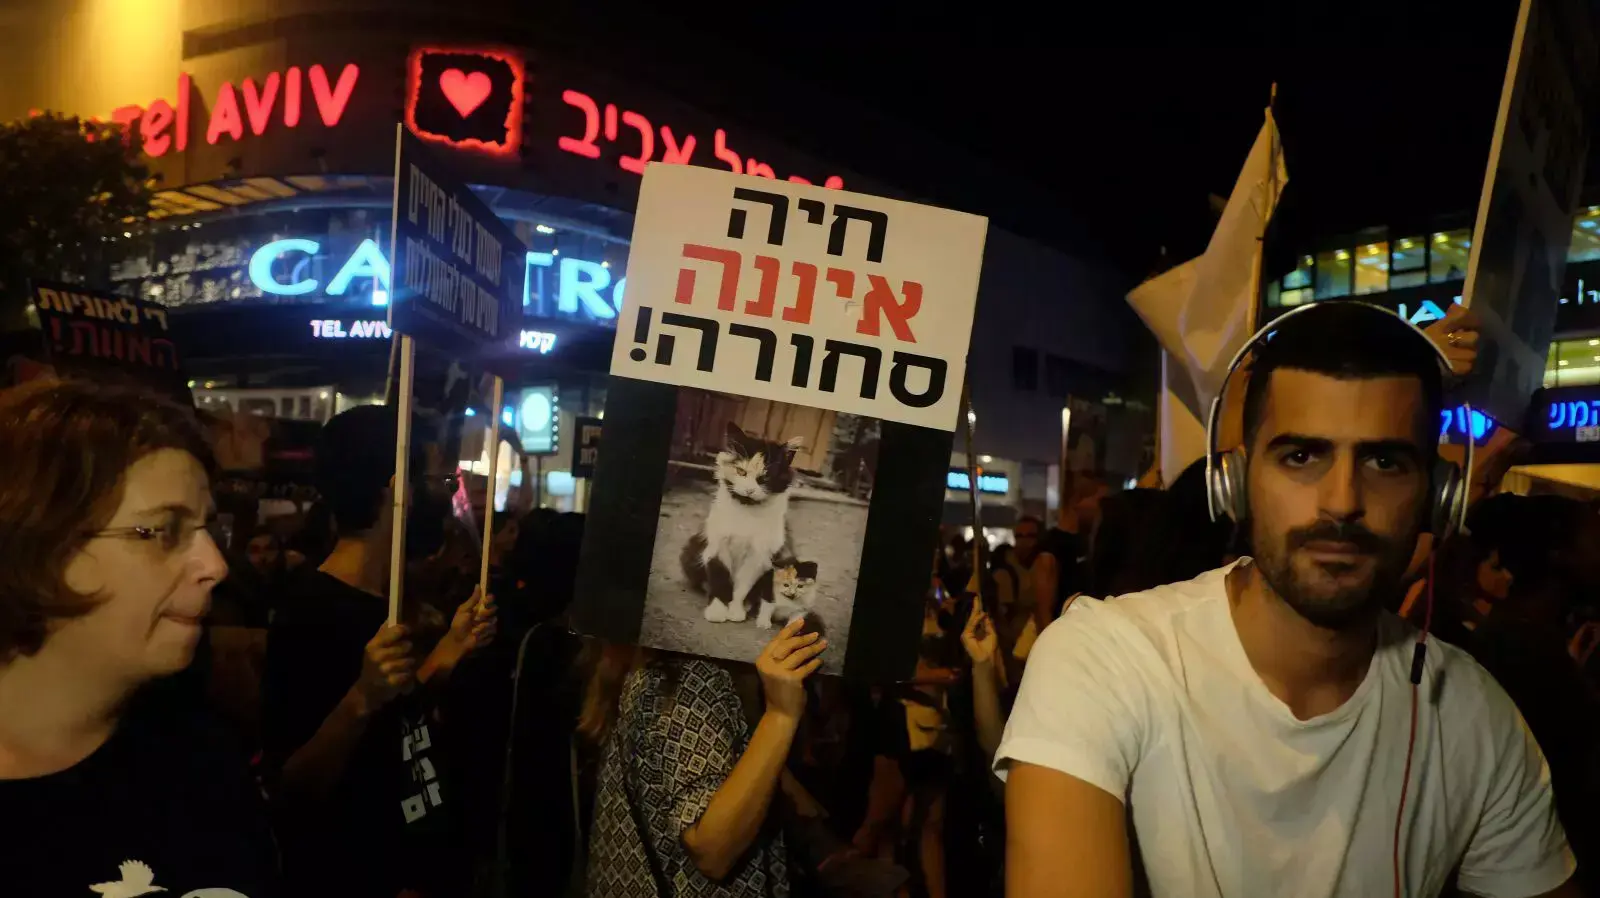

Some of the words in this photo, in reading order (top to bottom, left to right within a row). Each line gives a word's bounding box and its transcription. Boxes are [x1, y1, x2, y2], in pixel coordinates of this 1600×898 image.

[206, 63, 359, 145] AVIV
[559, 89, 697, 176] אביב
[408, 163, 447, 244] החיים
[727, 187, 888, 263] חיה
[310, 320, 347, 338] TEL
[350, 319, 392, 339] AVIV
[675, 243, 923, 343] איננה
[630, 306, 948, 408] סחורה!
